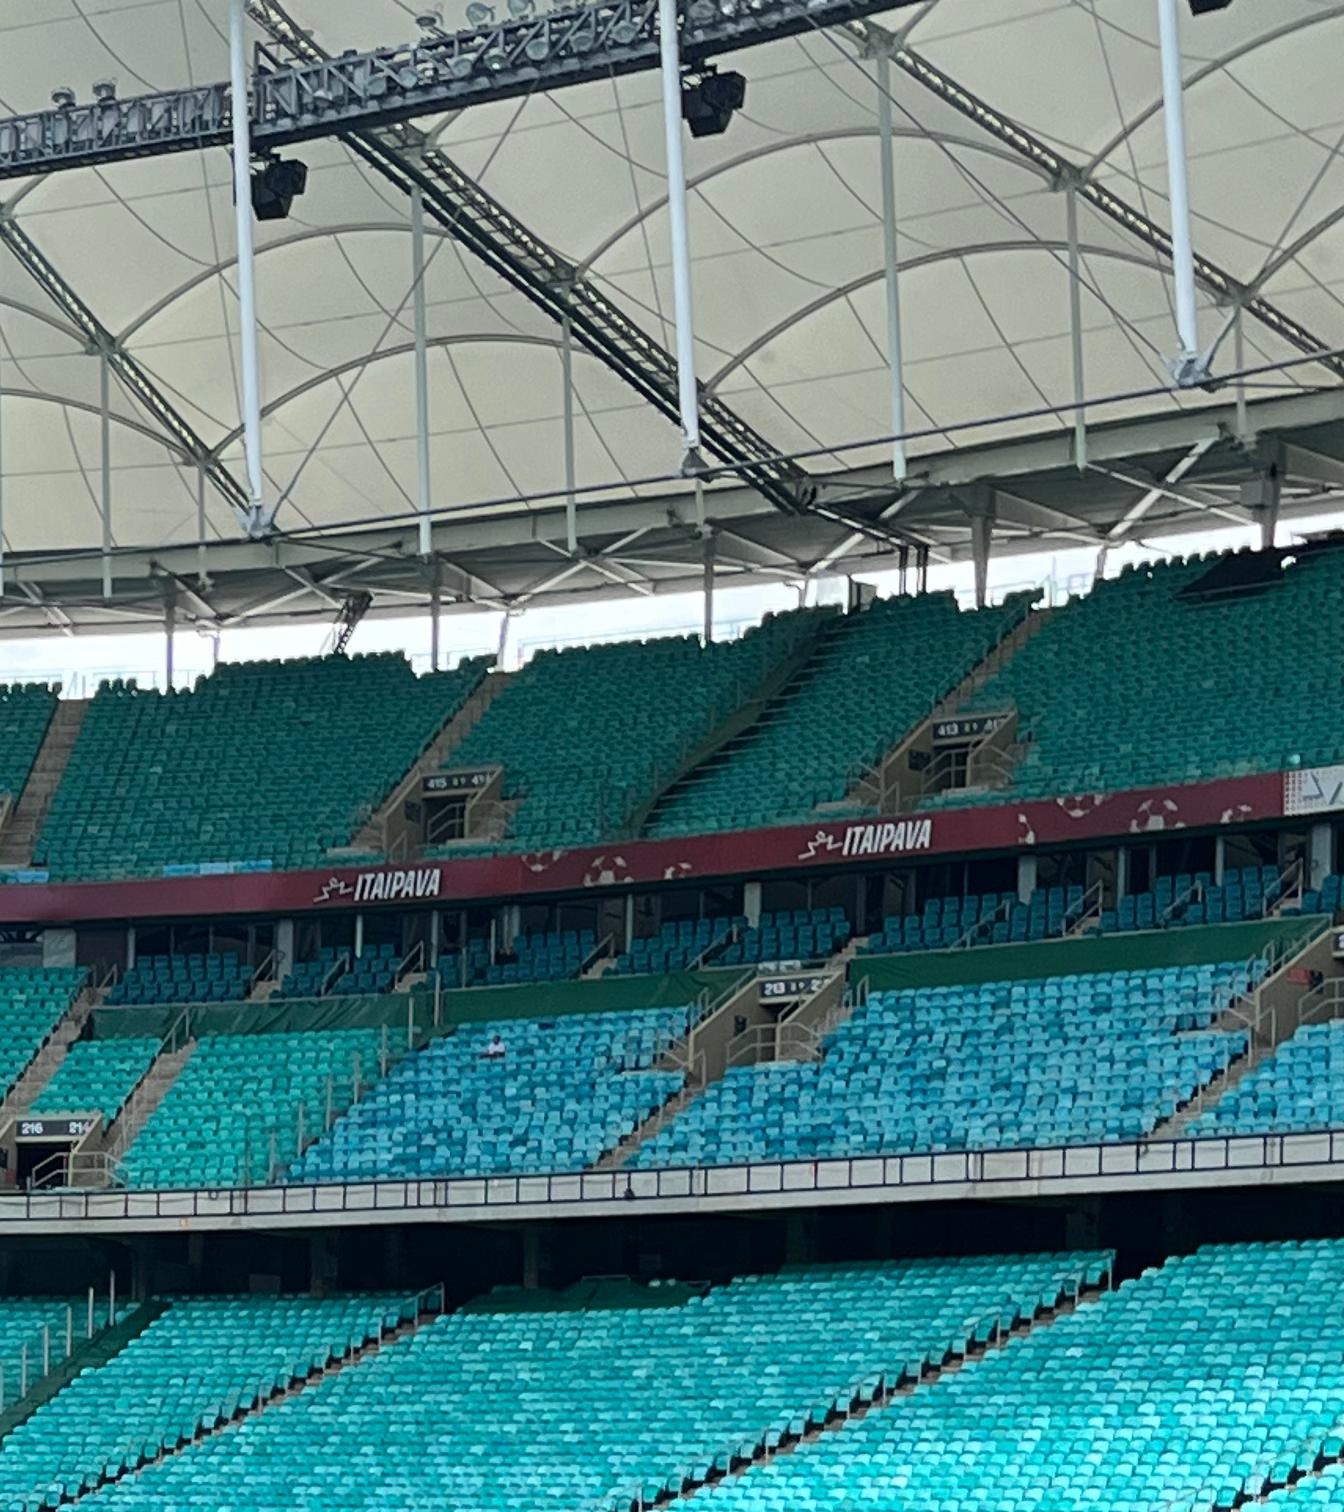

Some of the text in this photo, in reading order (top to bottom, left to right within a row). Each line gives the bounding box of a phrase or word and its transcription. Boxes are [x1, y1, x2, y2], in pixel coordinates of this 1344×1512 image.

[842, 819, 932, 856] ITAIPAVA
[354, 868, 440, 901] ITAIPAVA
[21, 1122, 43, 1135] 216
